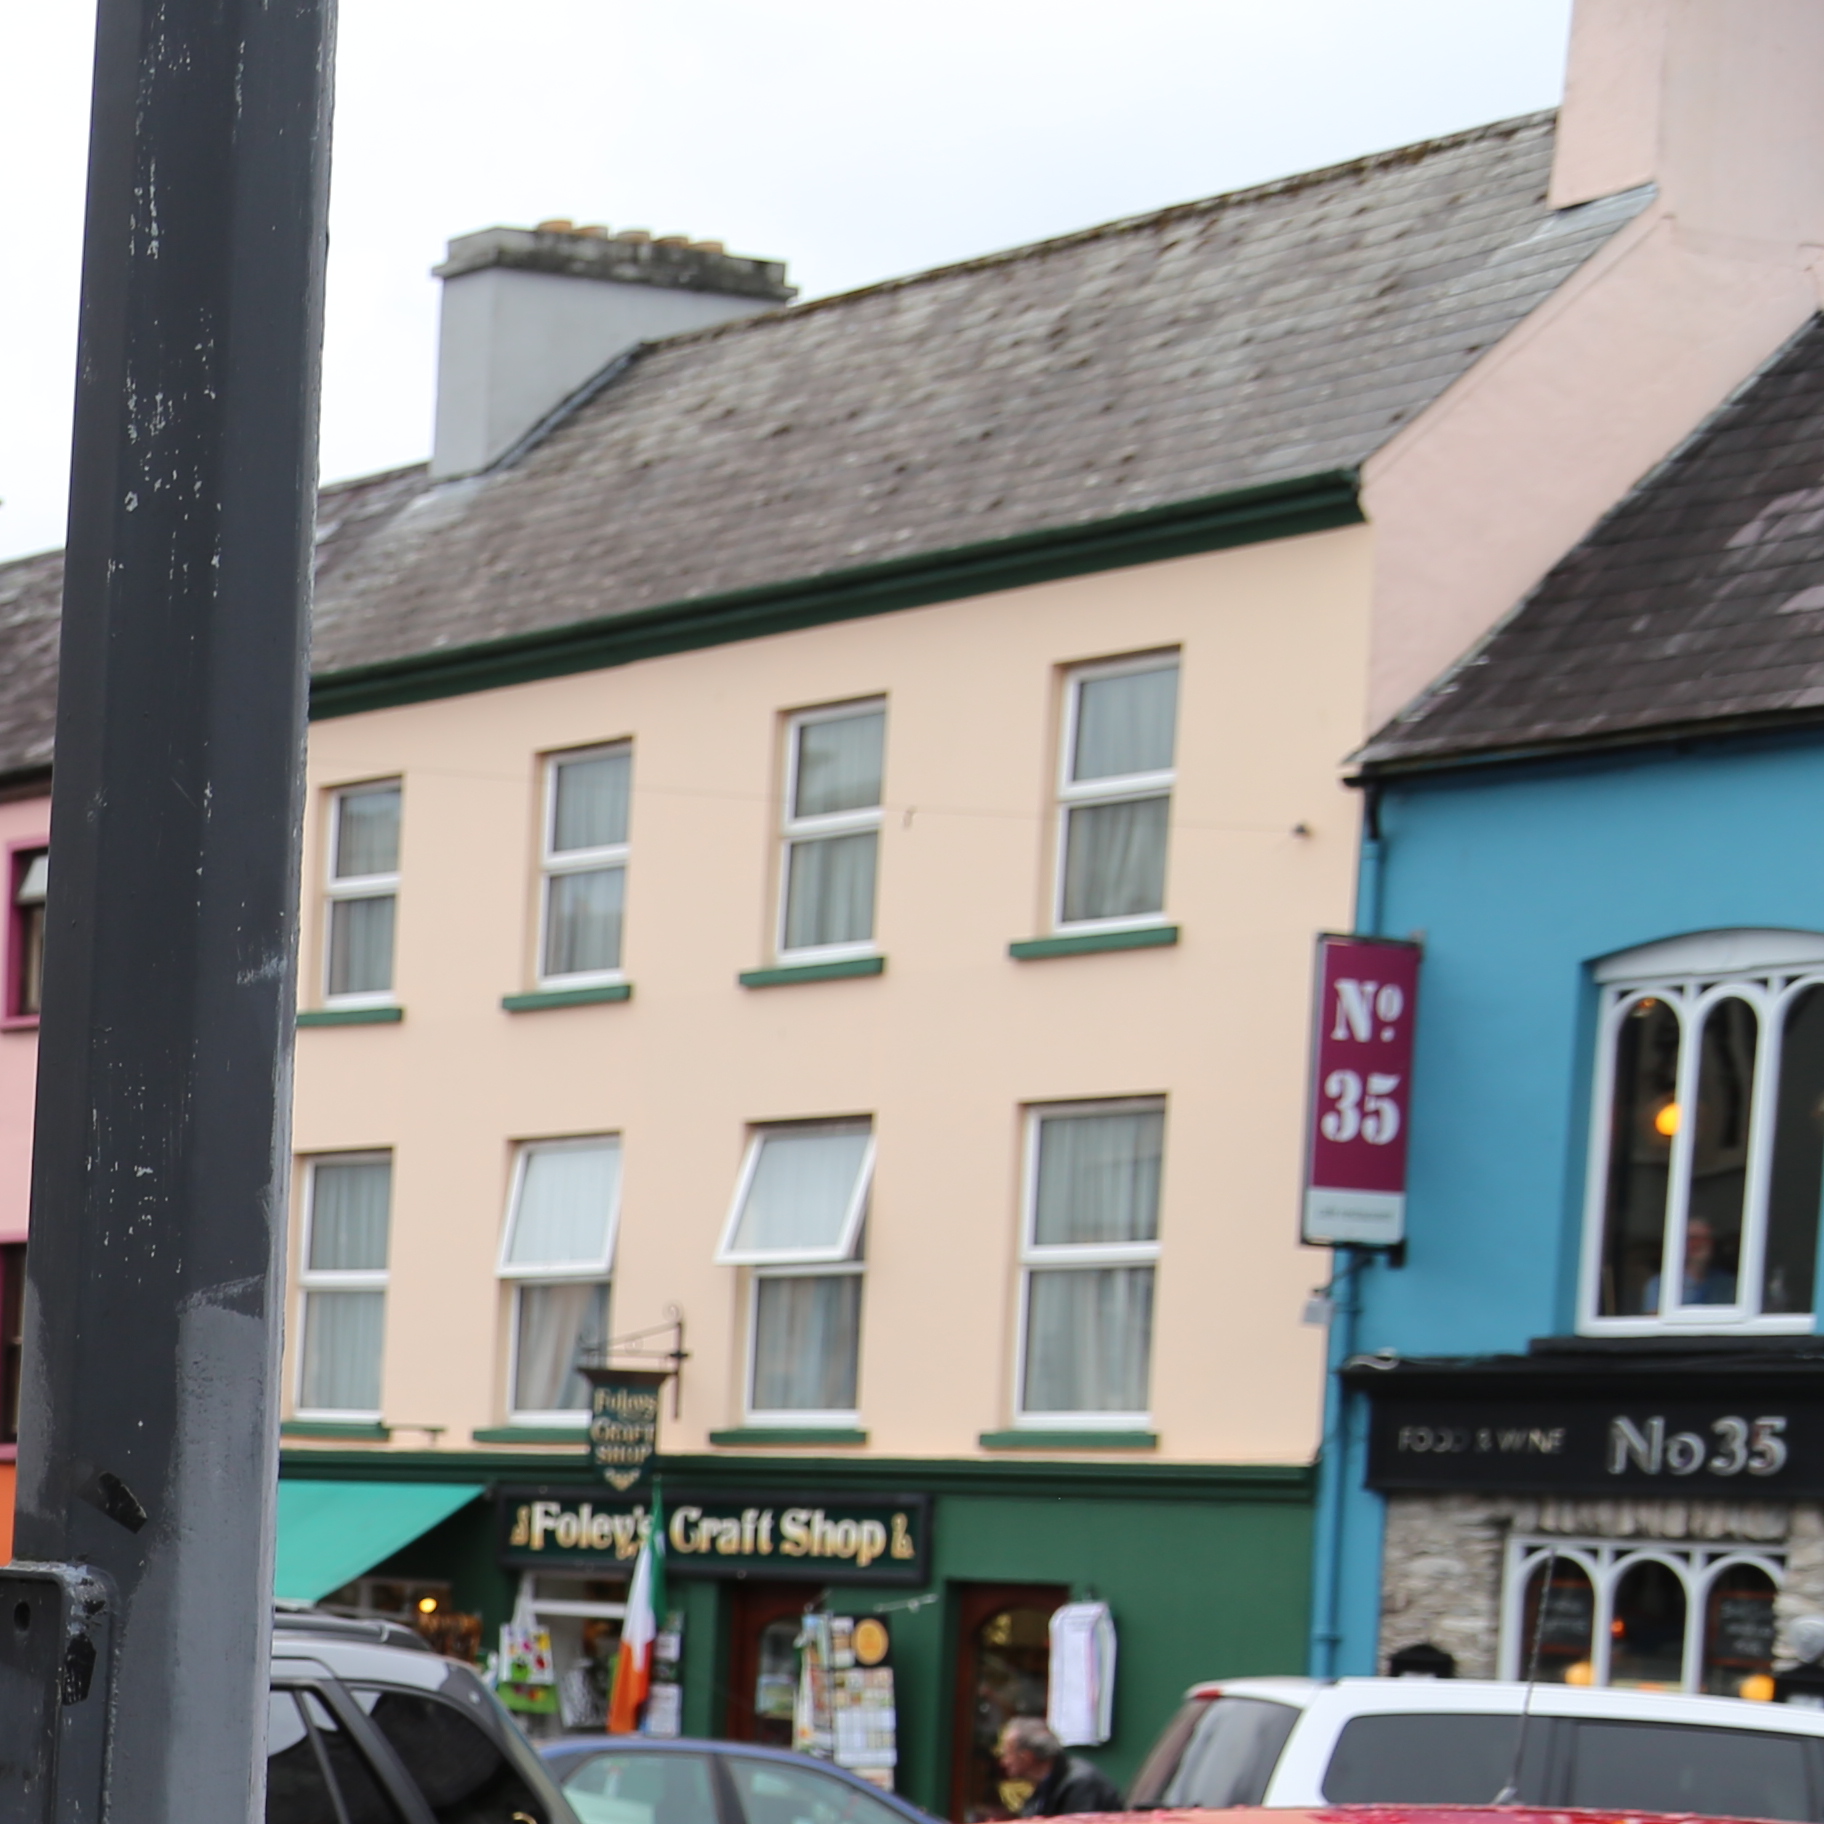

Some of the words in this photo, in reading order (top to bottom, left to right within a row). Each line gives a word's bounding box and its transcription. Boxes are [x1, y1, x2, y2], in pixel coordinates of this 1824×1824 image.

[1320, 1068, 1401, 1146] 35
[1496, 1427, 1566, 1454] WINE
[668, 1505, 775, 1556] Craft
[779, 1508, 887, 1568] Shop
